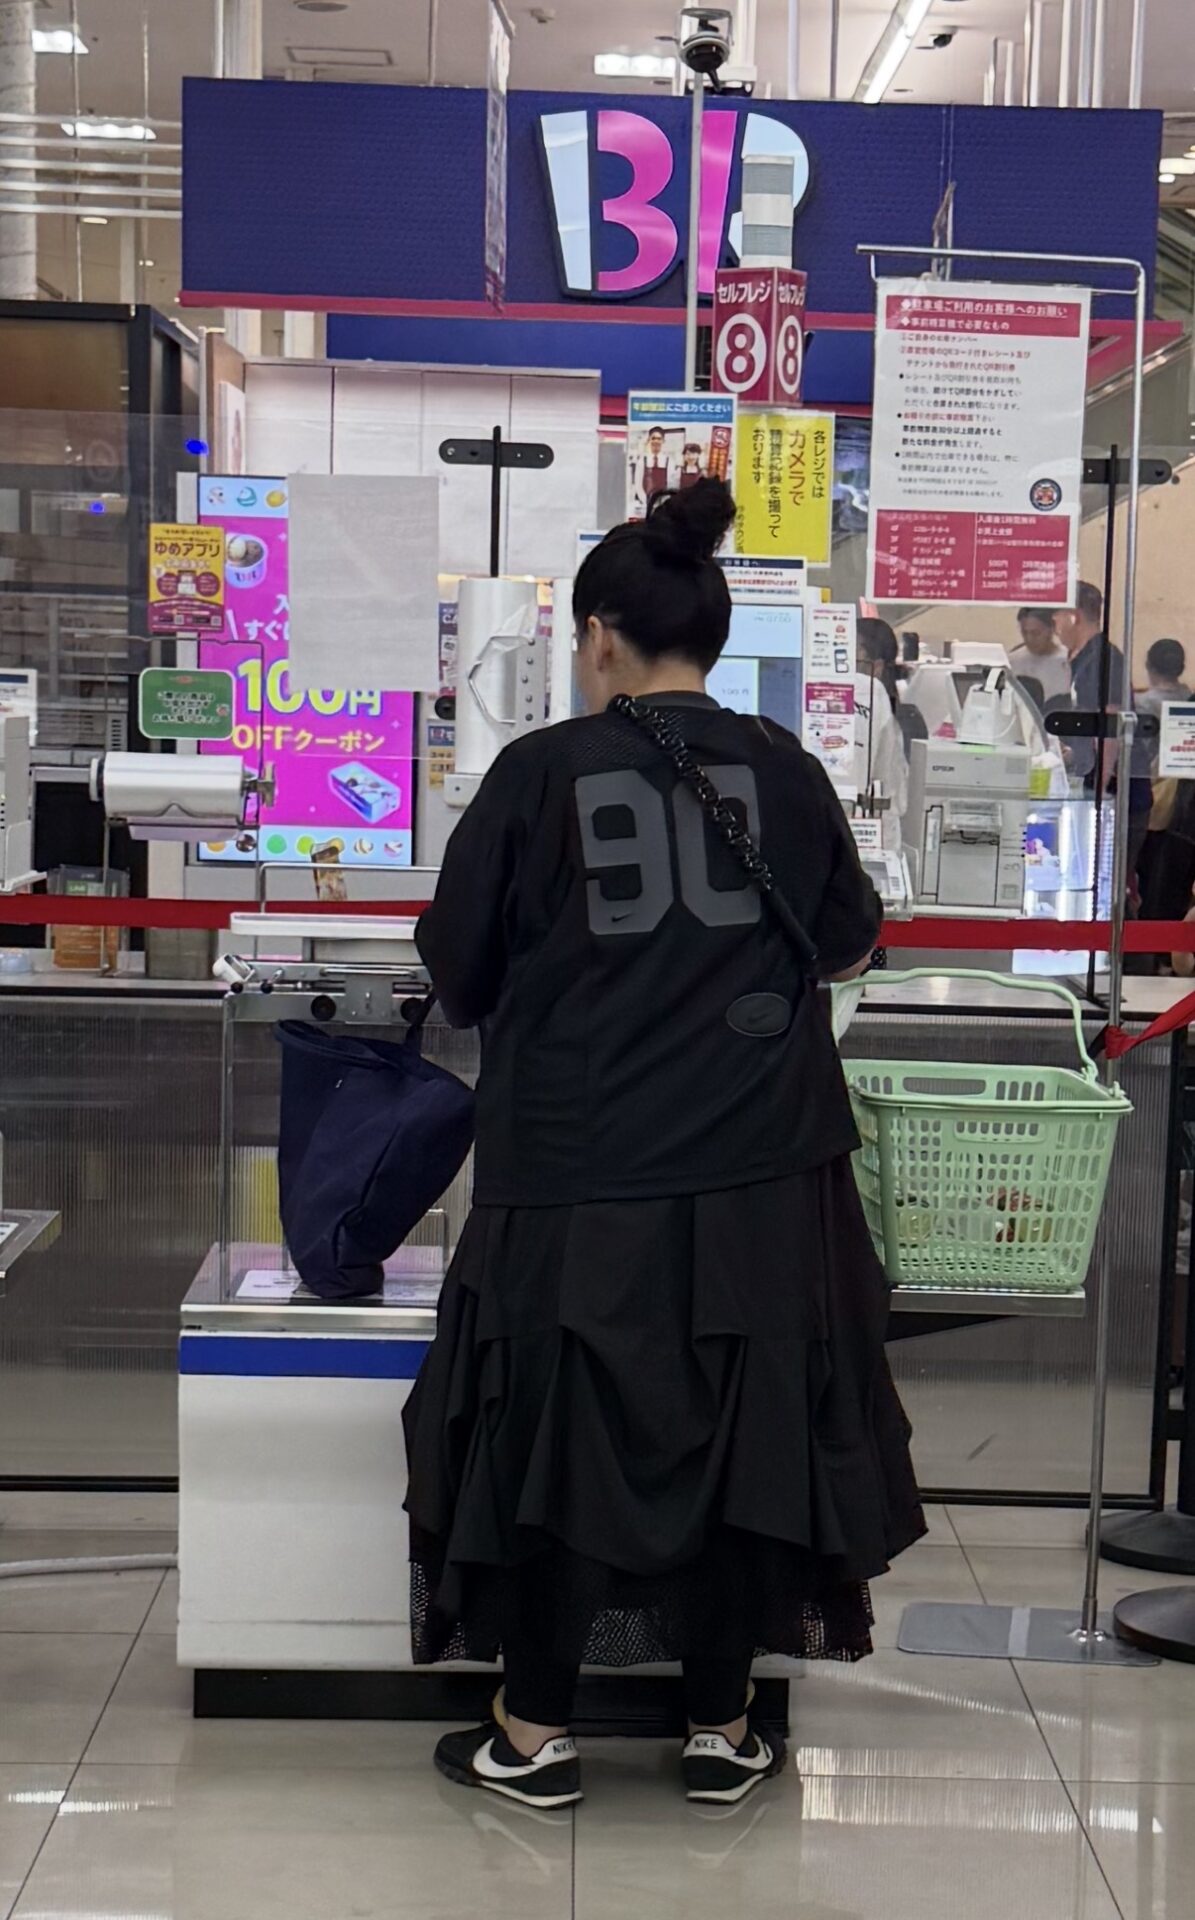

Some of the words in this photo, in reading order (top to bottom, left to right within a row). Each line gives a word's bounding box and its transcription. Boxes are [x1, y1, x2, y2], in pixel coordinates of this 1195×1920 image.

[717, 281, 771, 303] セルフレジ
[724, 323, 756, 384] 8
[782, 324, 798, 386] 8
[752, 429, 765, 485] おります
[788, 430, 806, 506] カメラで
[812, 430, 826, 498] 各レジでは
[154, 543, 220, 557] ゆめアプリ
[575, 764, 761, 935] 90
[693, 1738, 718, 1750] NIKE
